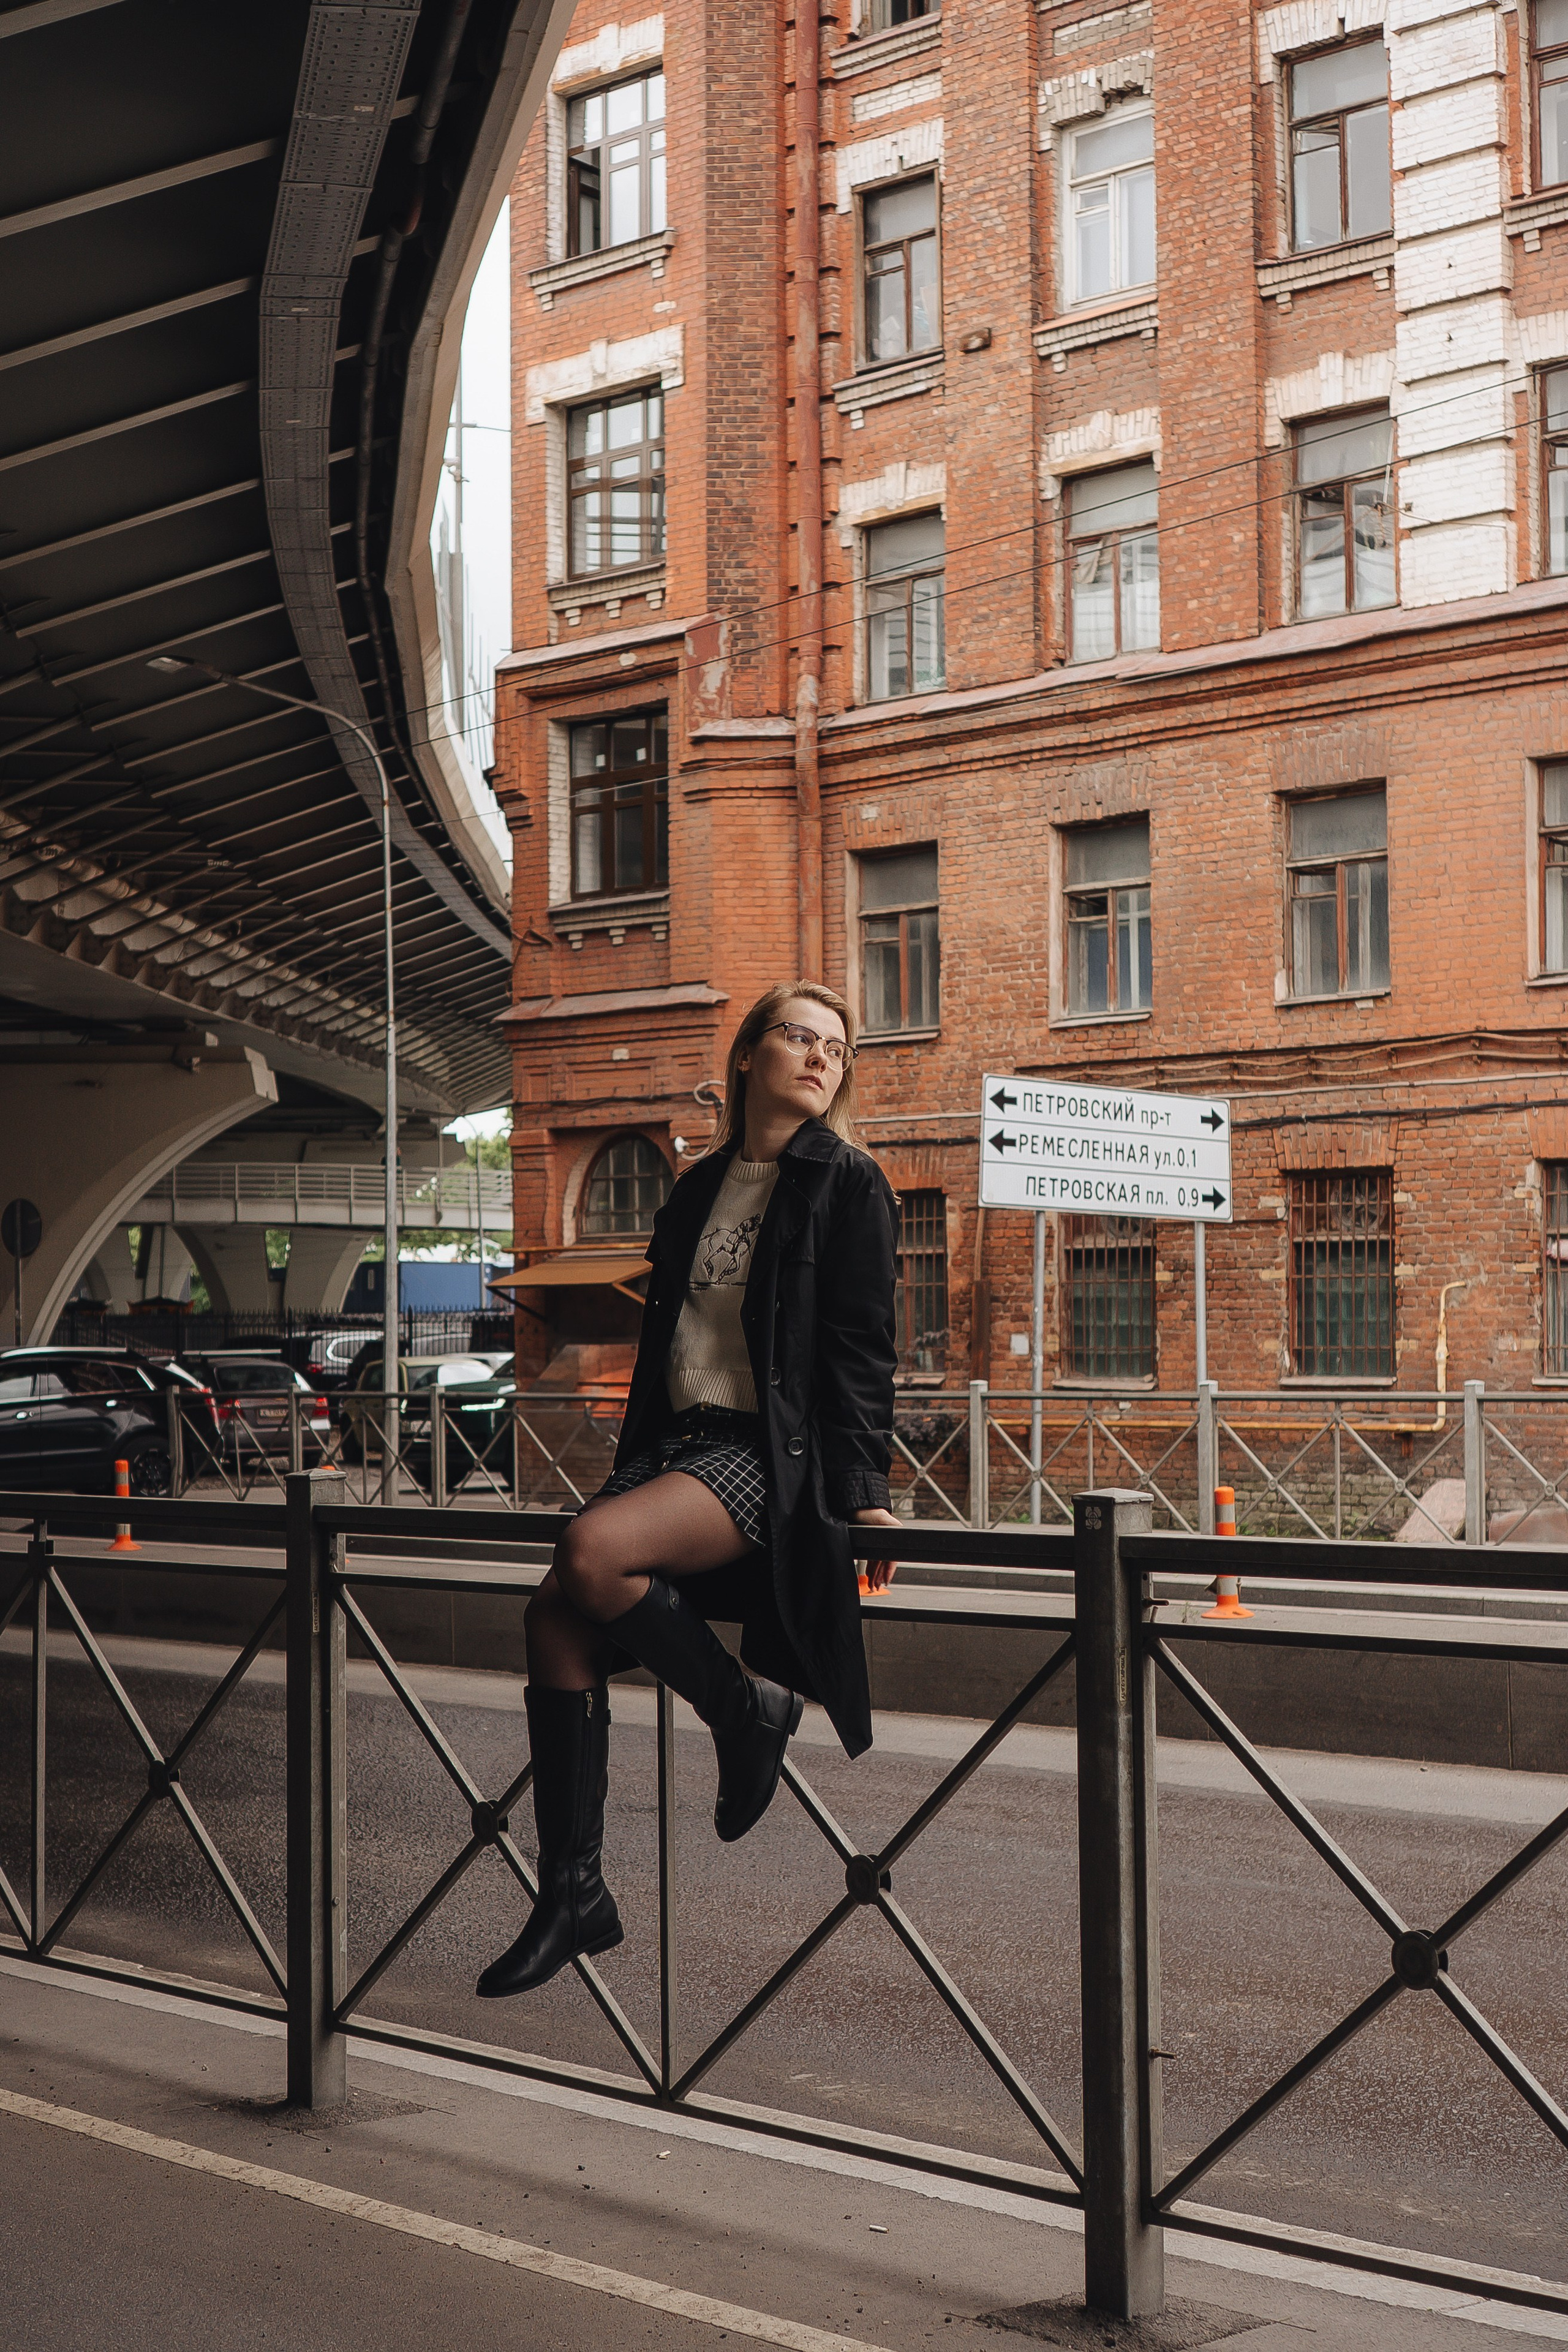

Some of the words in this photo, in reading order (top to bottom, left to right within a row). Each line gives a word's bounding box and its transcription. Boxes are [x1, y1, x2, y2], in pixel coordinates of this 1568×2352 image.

[1023, 1093, 1134, 1121] ПЕТРОВСКИЙ
[1141, 1110, 1170, 1129] пр-т
[1019, 1134, 1148, 1163] РЕМЕСЛЕННАЯ
[1026, 1177, 1140, 1203] ПЕТРОВСКАЯ
[1146, 1191, 1168, 1205] пл.
